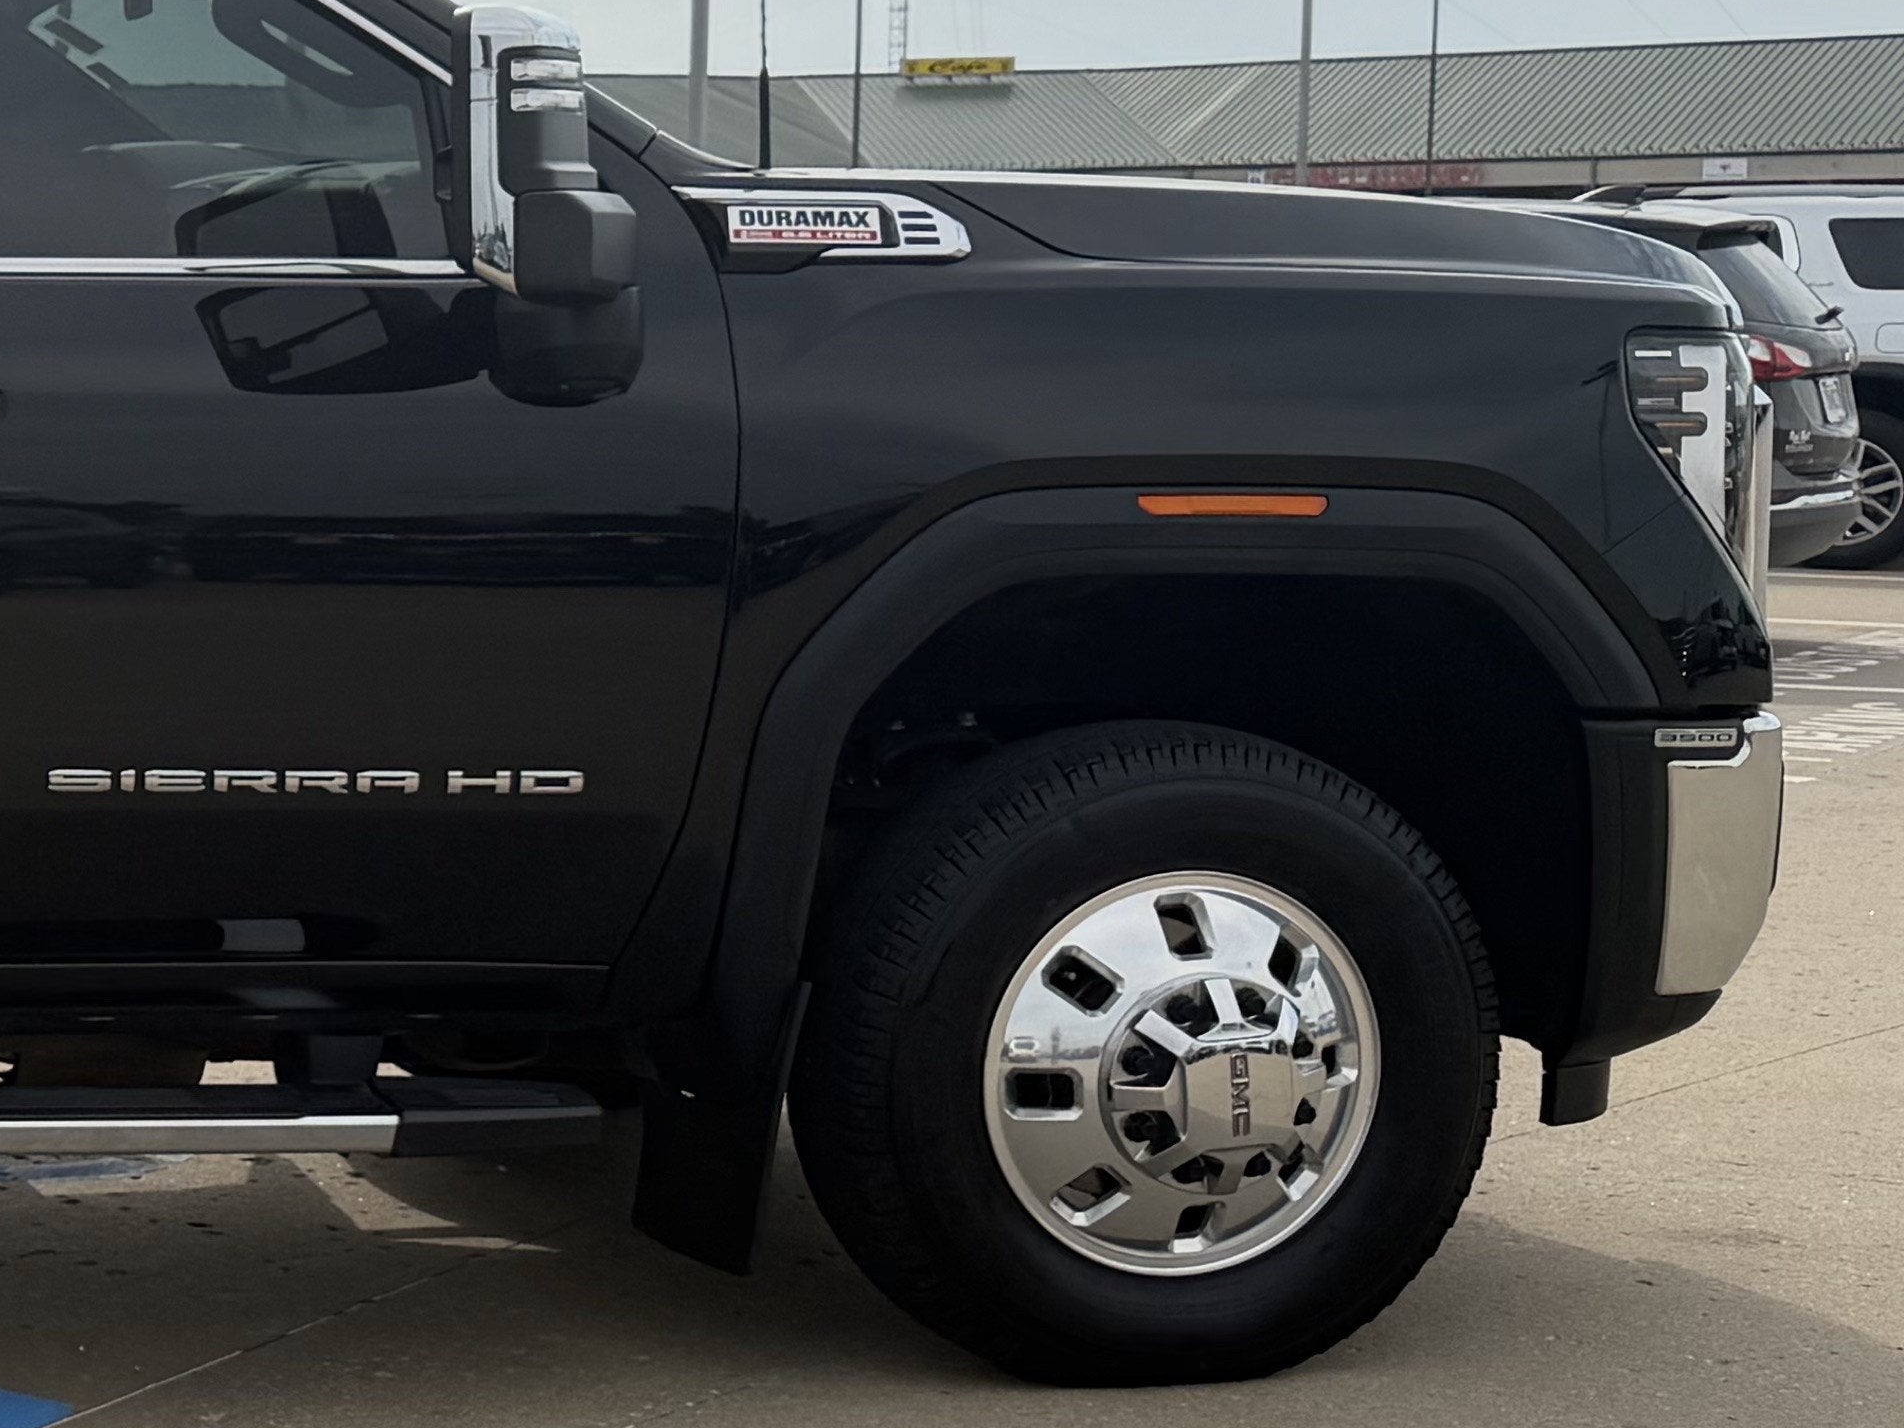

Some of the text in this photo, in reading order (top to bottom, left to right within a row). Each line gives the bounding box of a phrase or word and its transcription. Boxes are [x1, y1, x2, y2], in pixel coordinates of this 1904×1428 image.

[739, 209, 871, 228] DURAMAX
[47, 768, 585, 795] SIERRA HD
[1229, 1052, 1251, 1137] GMC
